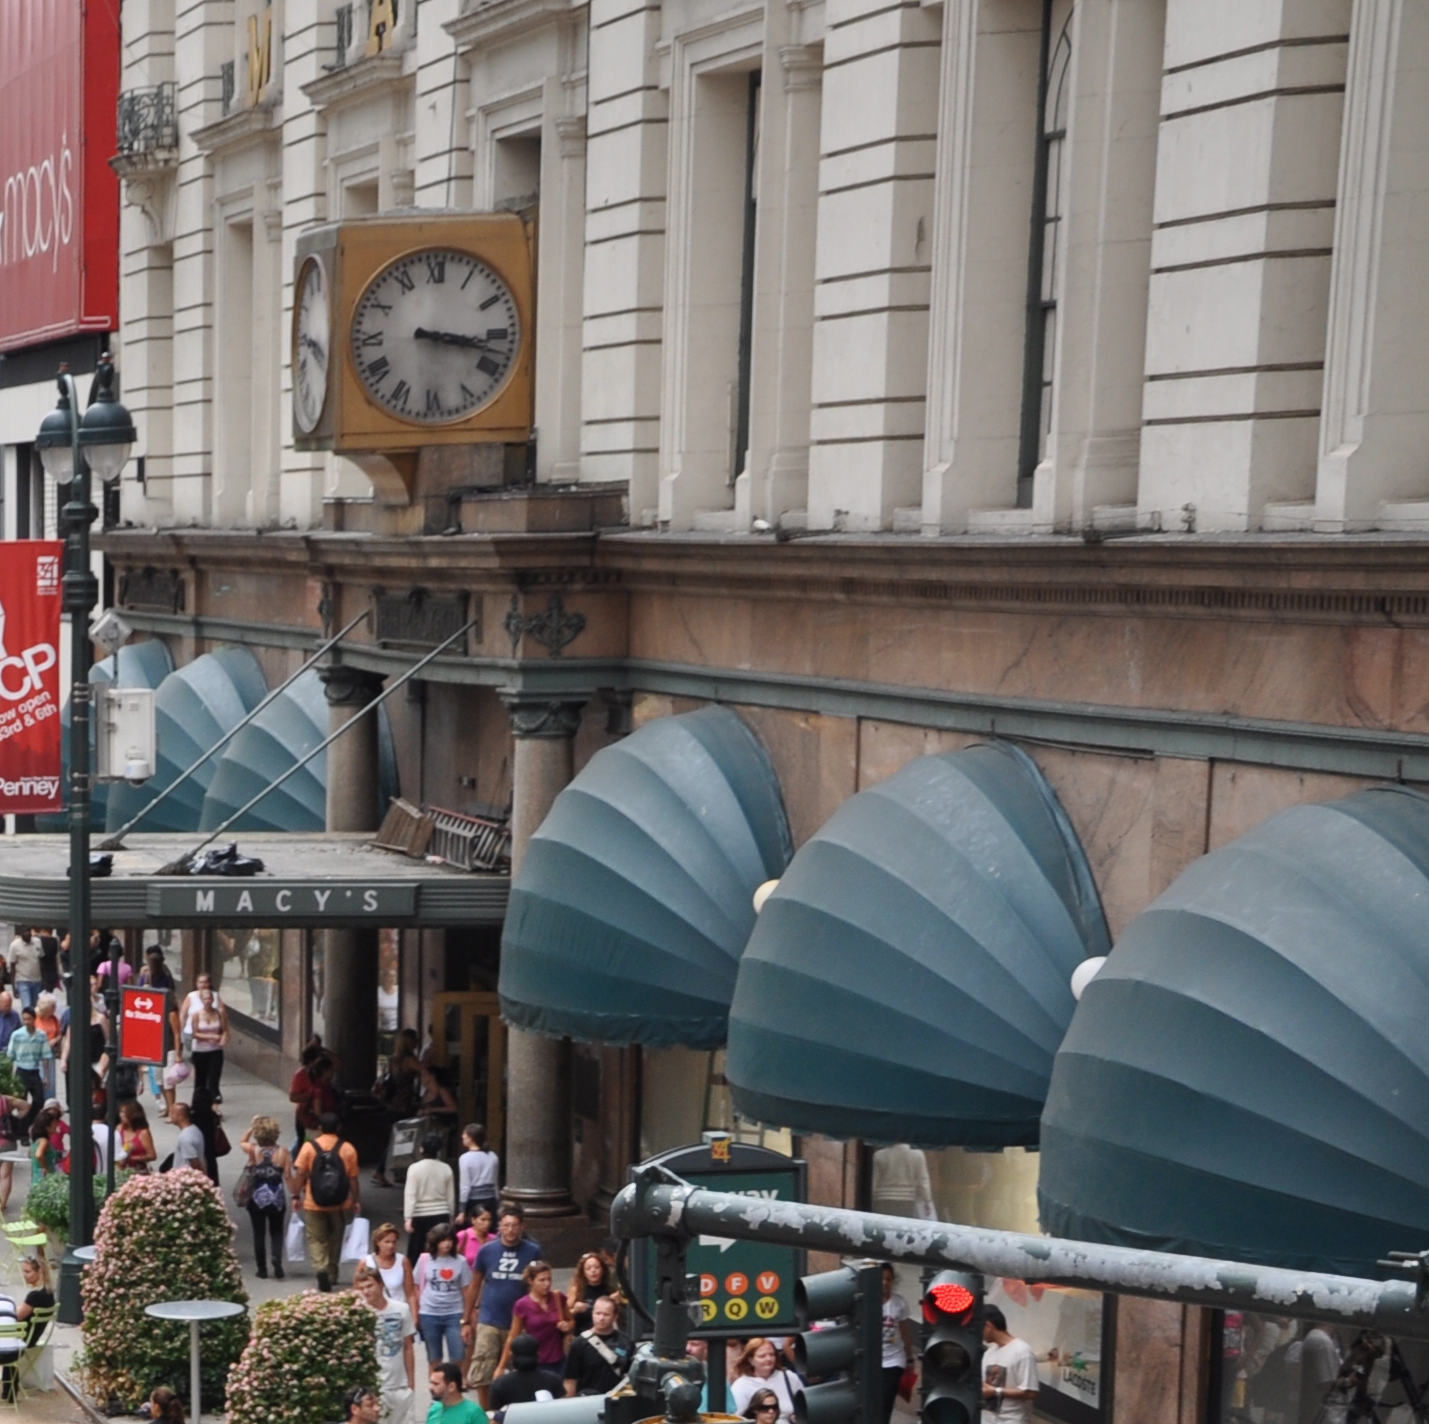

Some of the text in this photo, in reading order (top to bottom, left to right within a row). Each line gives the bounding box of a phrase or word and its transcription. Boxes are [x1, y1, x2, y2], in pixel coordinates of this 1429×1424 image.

[18, 690, 52, 715] open
[24, 714, 36, 728] &
[37, 702, 58, 720] 6th
[195, 888, 379, 913] MACY'S
[498, 1258, 519, 1272] 27
[700, 1276, 775, 1292] D F V
[728, 1302, 743, 1317] Q
[758, 1302, 776, 1315] W
[1062, 1368, 1096, 1397] LACOSTE
